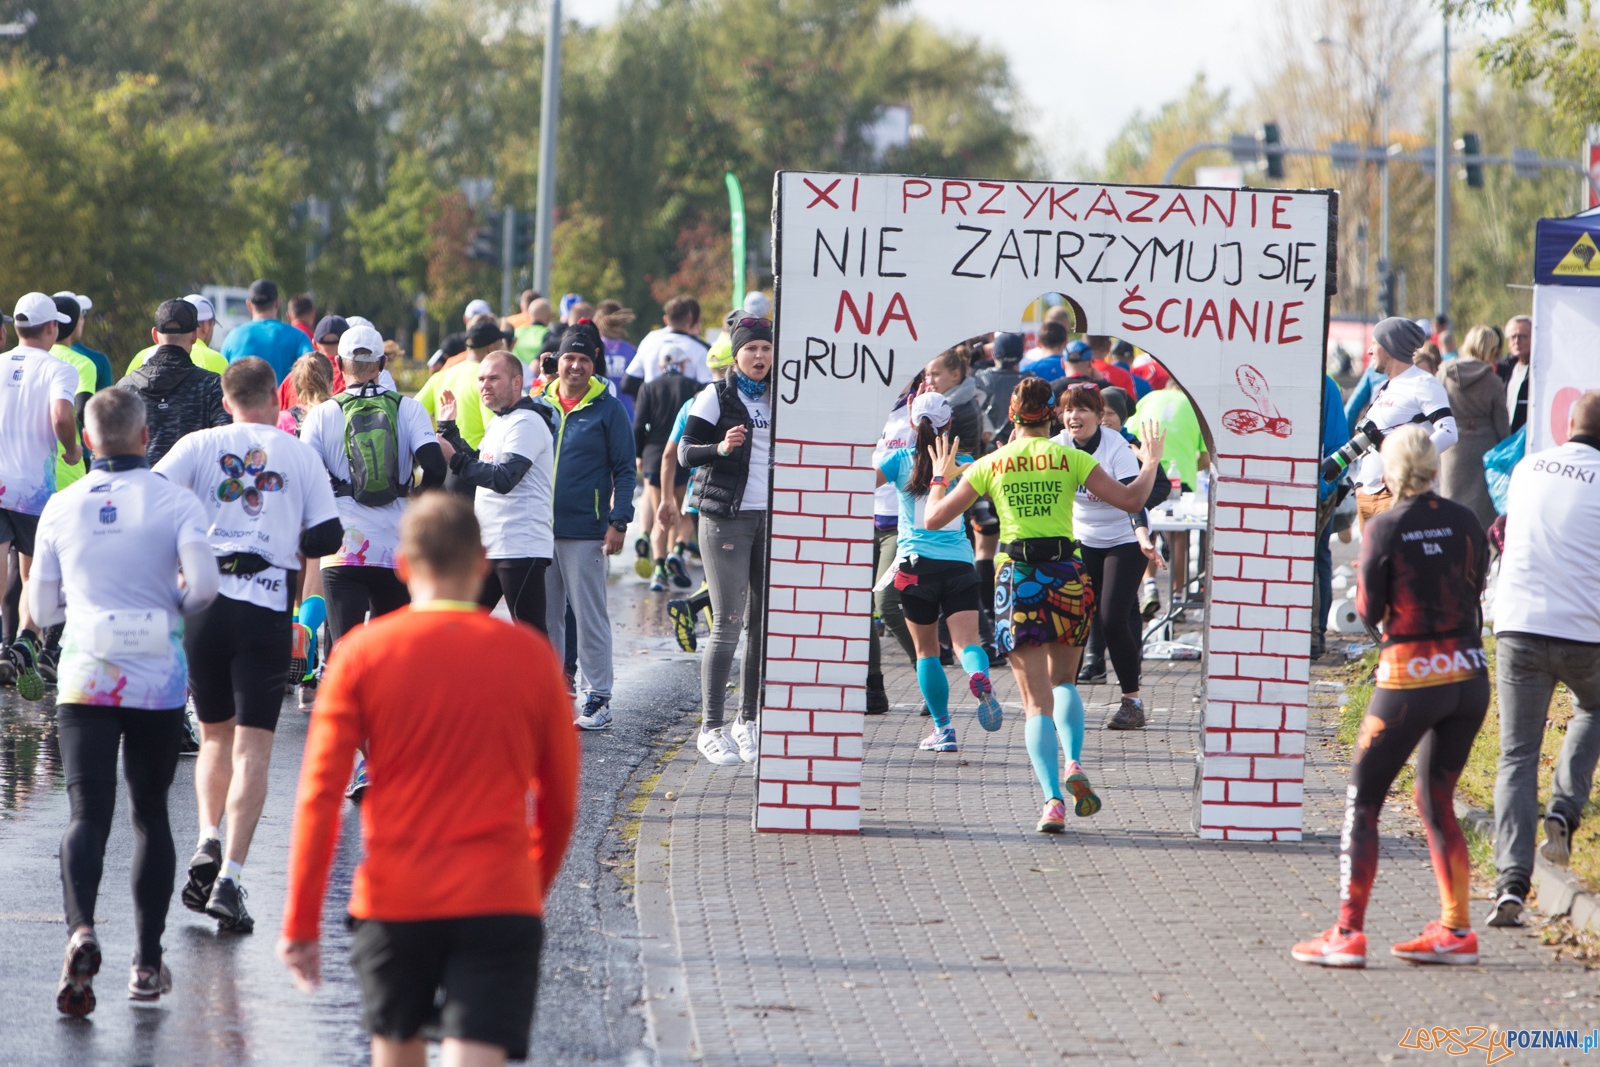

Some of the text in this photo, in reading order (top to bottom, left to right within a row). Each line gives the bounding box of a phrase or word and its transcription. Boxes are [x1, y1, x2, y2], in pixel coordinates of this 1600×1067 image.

[802, 177, 1294, 230] XI PRZYKAZANIE
[812, 222, 1318, 291] NIE ZATRZYMUJ SIĘ
[834, 283, 1305, 345] NA ŚCIANIE
[780, 336, 895, 405] gRUN
[991, 453, 1070, 477] MARIOLA
[1533, 459, 1596, 484] BORKI
[1002, 480, 1063, 495] POSITIVE
[1007, 493, 1060, 507] ENERGY
[1016, 505, 1052, 518] TEAM
